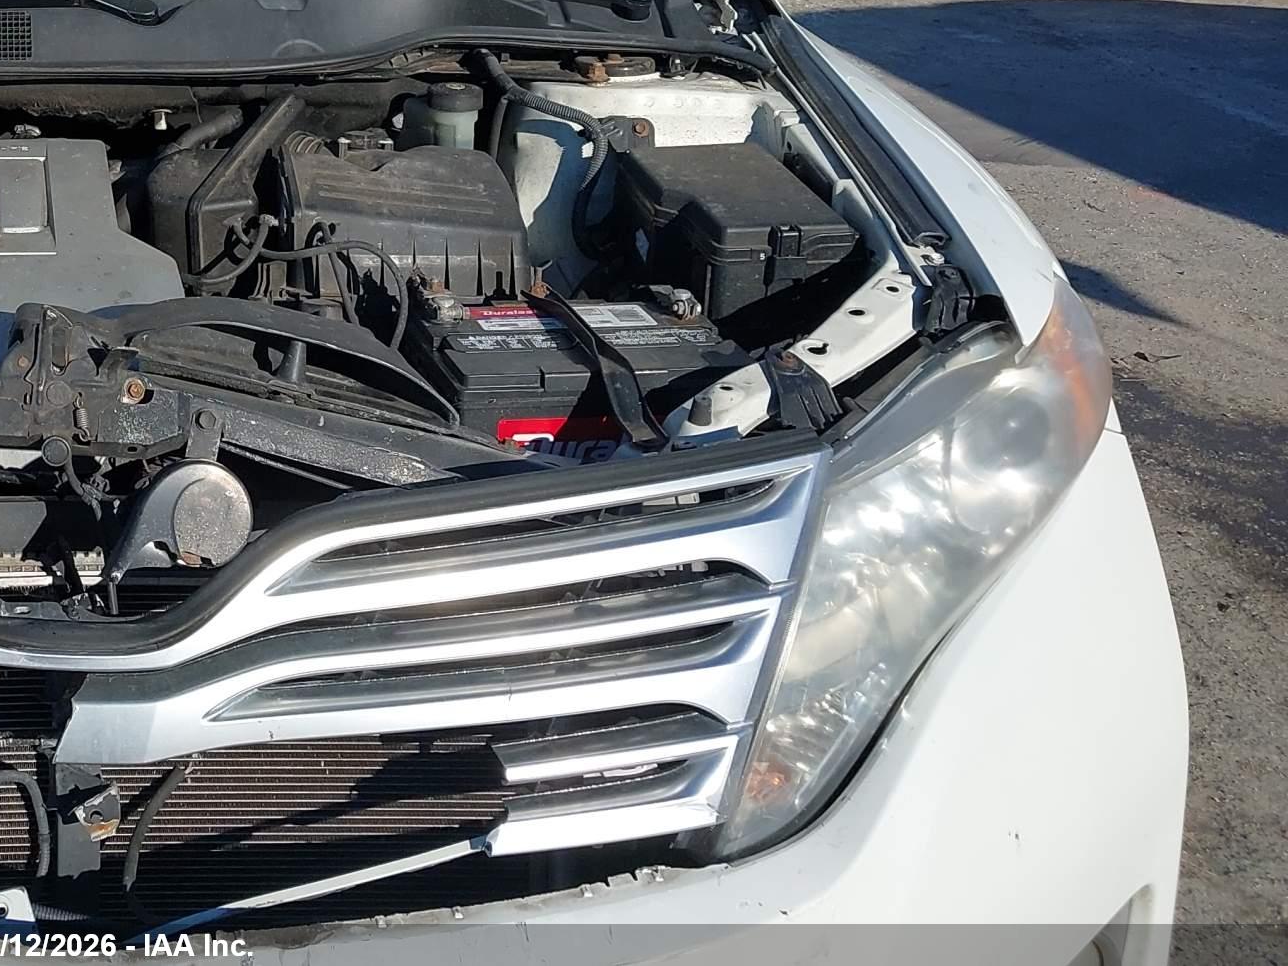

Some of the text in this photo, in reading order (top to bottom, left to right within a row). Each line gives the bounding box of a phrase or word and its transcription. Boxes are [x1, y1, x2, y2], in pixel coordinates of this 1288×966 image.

[759, 252, 766, 261] 5
[479, 309, 535, 317] Duralas
[511, 432, 620, 462] Dura
